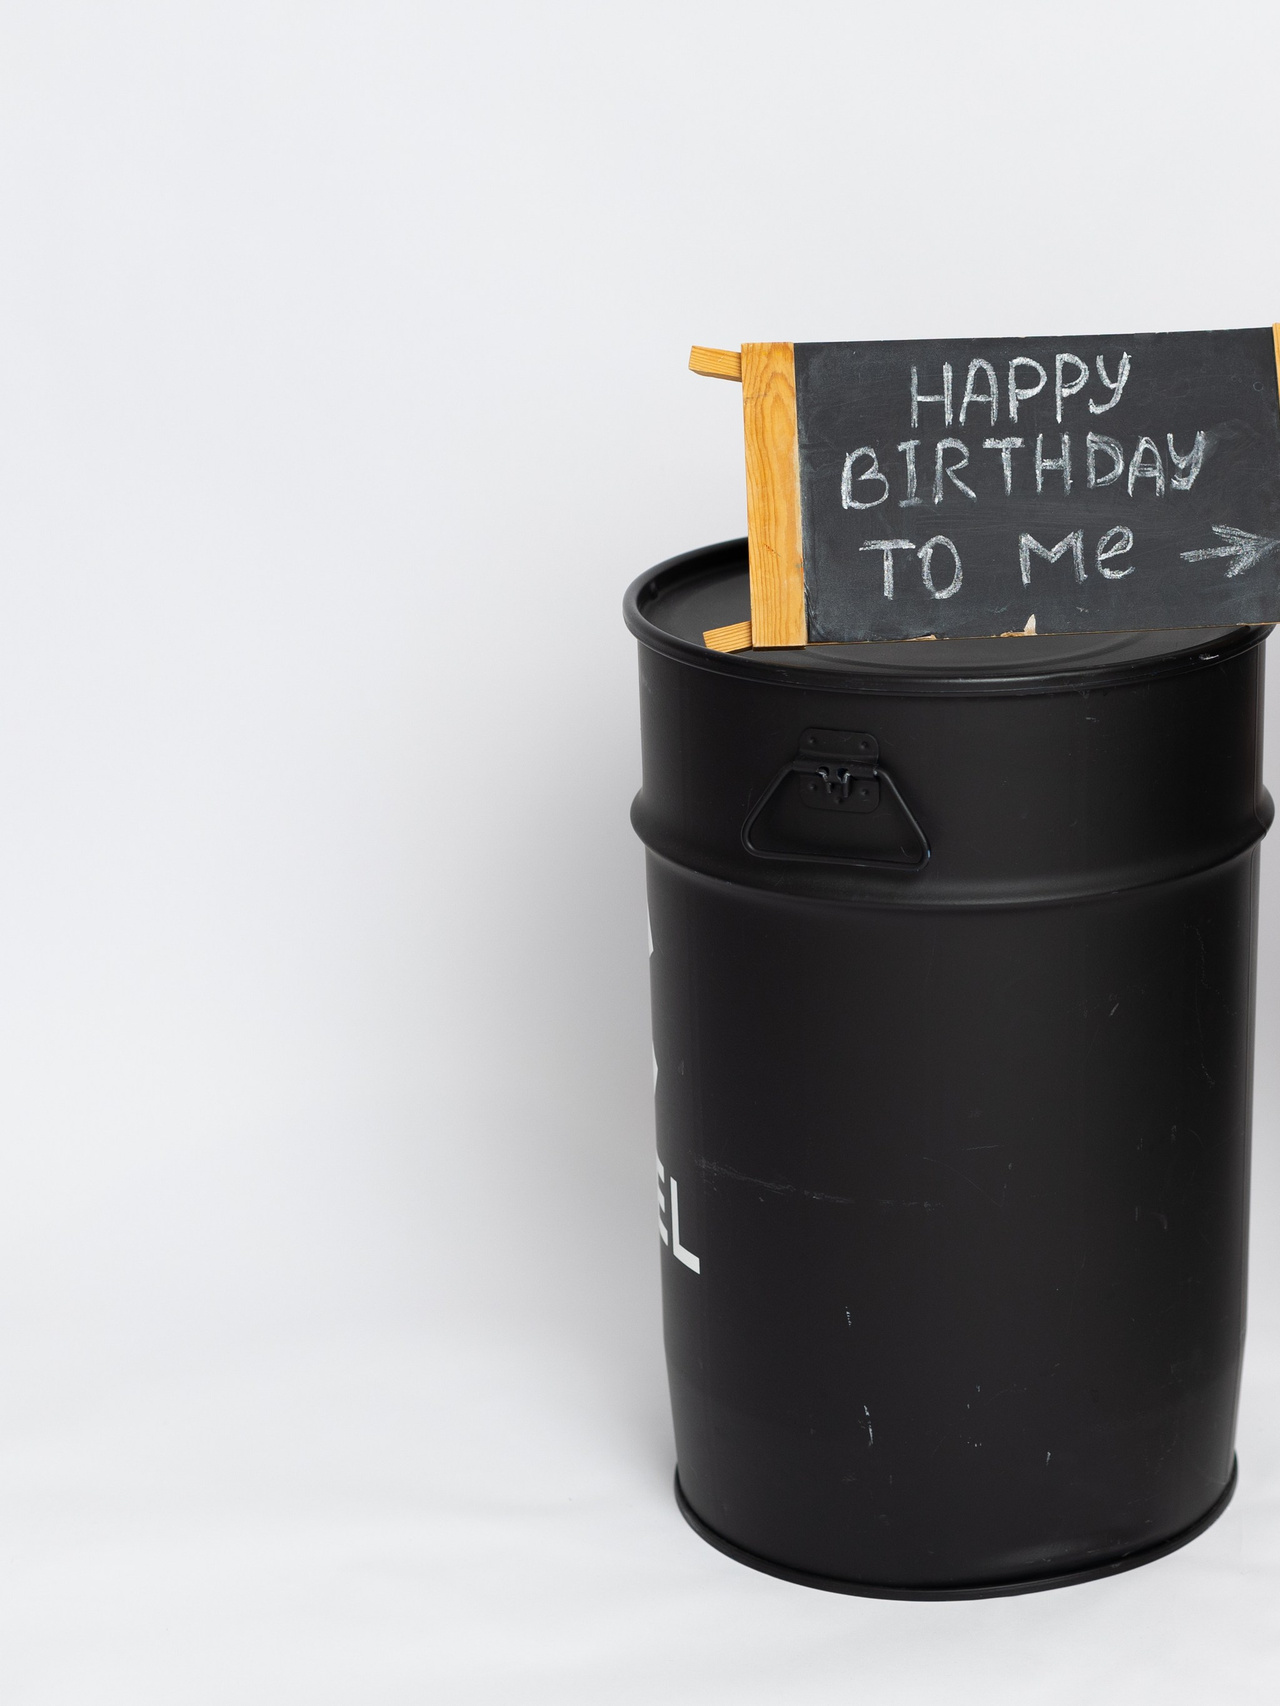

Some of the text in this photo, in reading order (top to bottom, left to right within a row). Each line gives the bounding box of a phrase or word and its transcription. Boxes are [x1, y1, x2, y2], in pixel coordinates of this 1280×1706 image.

[910, 351, 1132, 428] HAPPY
[841, 431, 1206, 510] BIRTHDAY
[859, 535, 964, 600] TO
